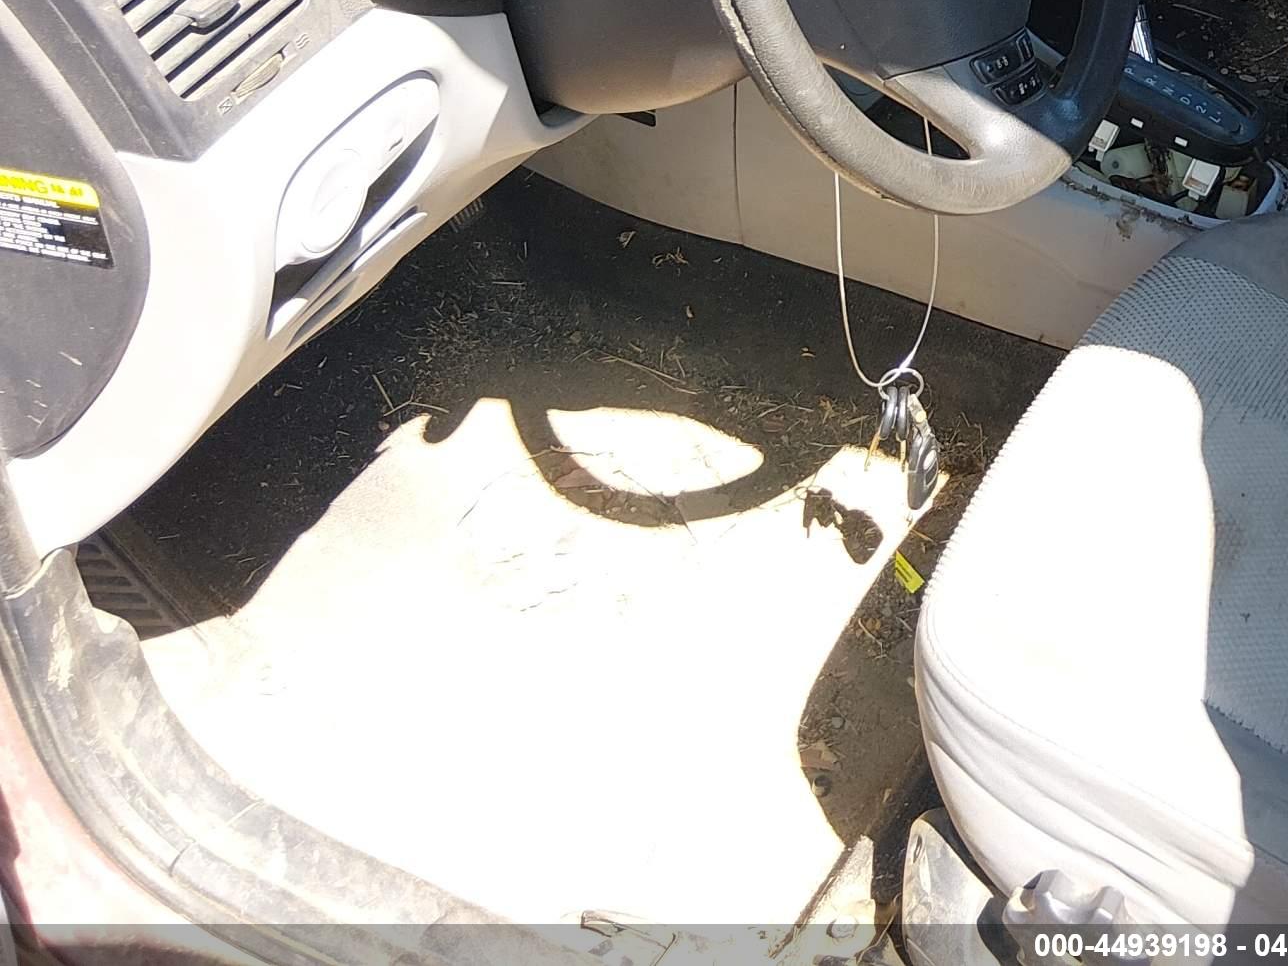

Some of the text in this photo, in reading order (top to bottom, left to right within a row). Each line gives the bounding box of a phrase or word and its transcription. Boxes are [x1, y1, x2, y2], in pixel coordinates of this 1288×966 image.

[1123, 66, 1135, 76] P
[1144, 77, 1157, 87] R
[1179, 95, 1191, 106] D
[1195, 104, 1208, 115] 2
[1208, 114, 1222, 124] L
